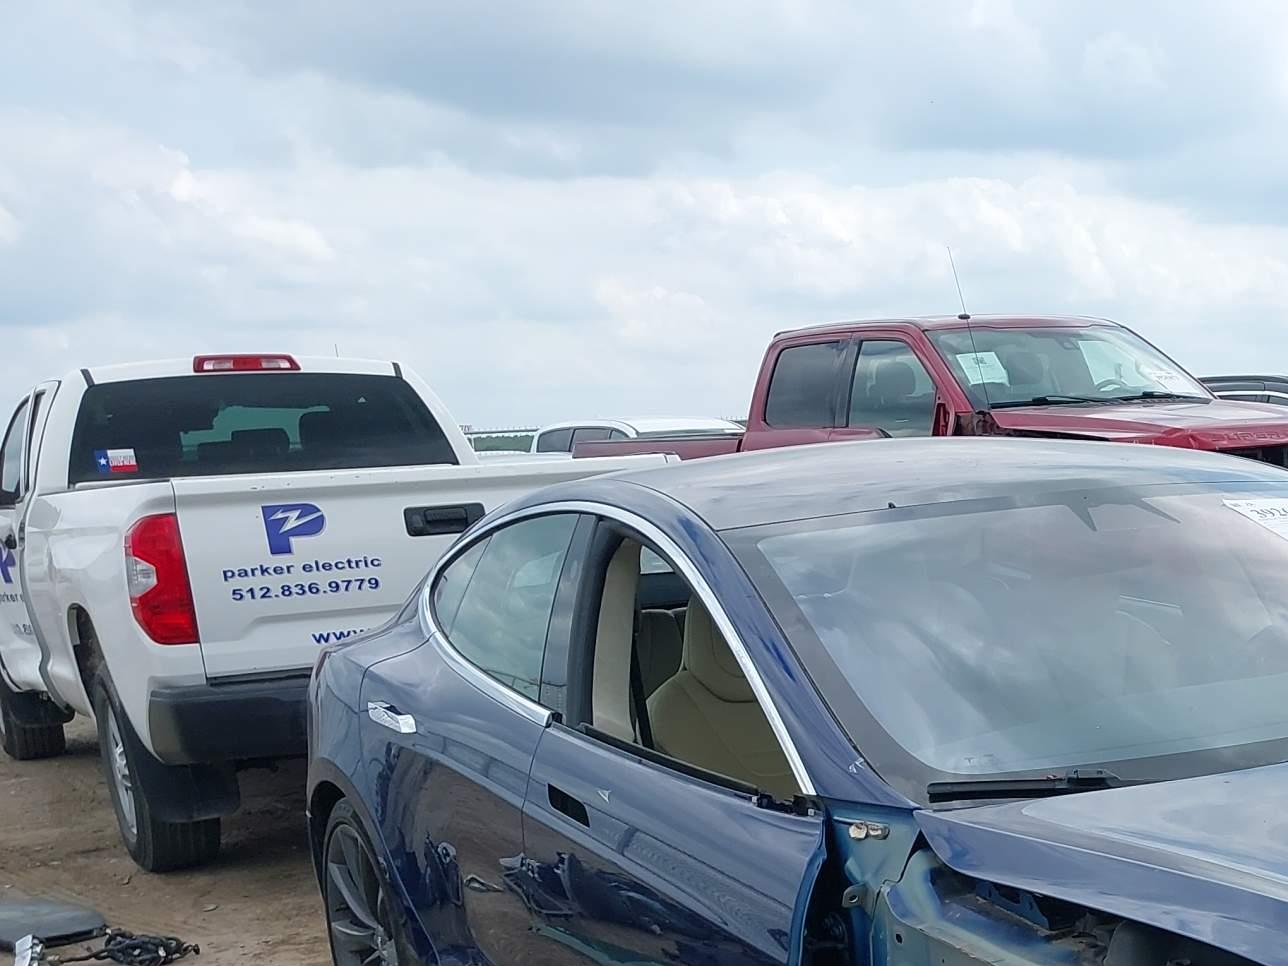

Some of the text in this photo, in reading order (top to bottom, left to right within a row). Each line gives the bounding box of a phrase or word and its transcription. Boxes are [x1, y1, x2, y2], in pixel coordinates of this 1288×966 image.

[222, 556, 382, 581] parker electric
[231, 577, 380, 601] 512.836.9779
